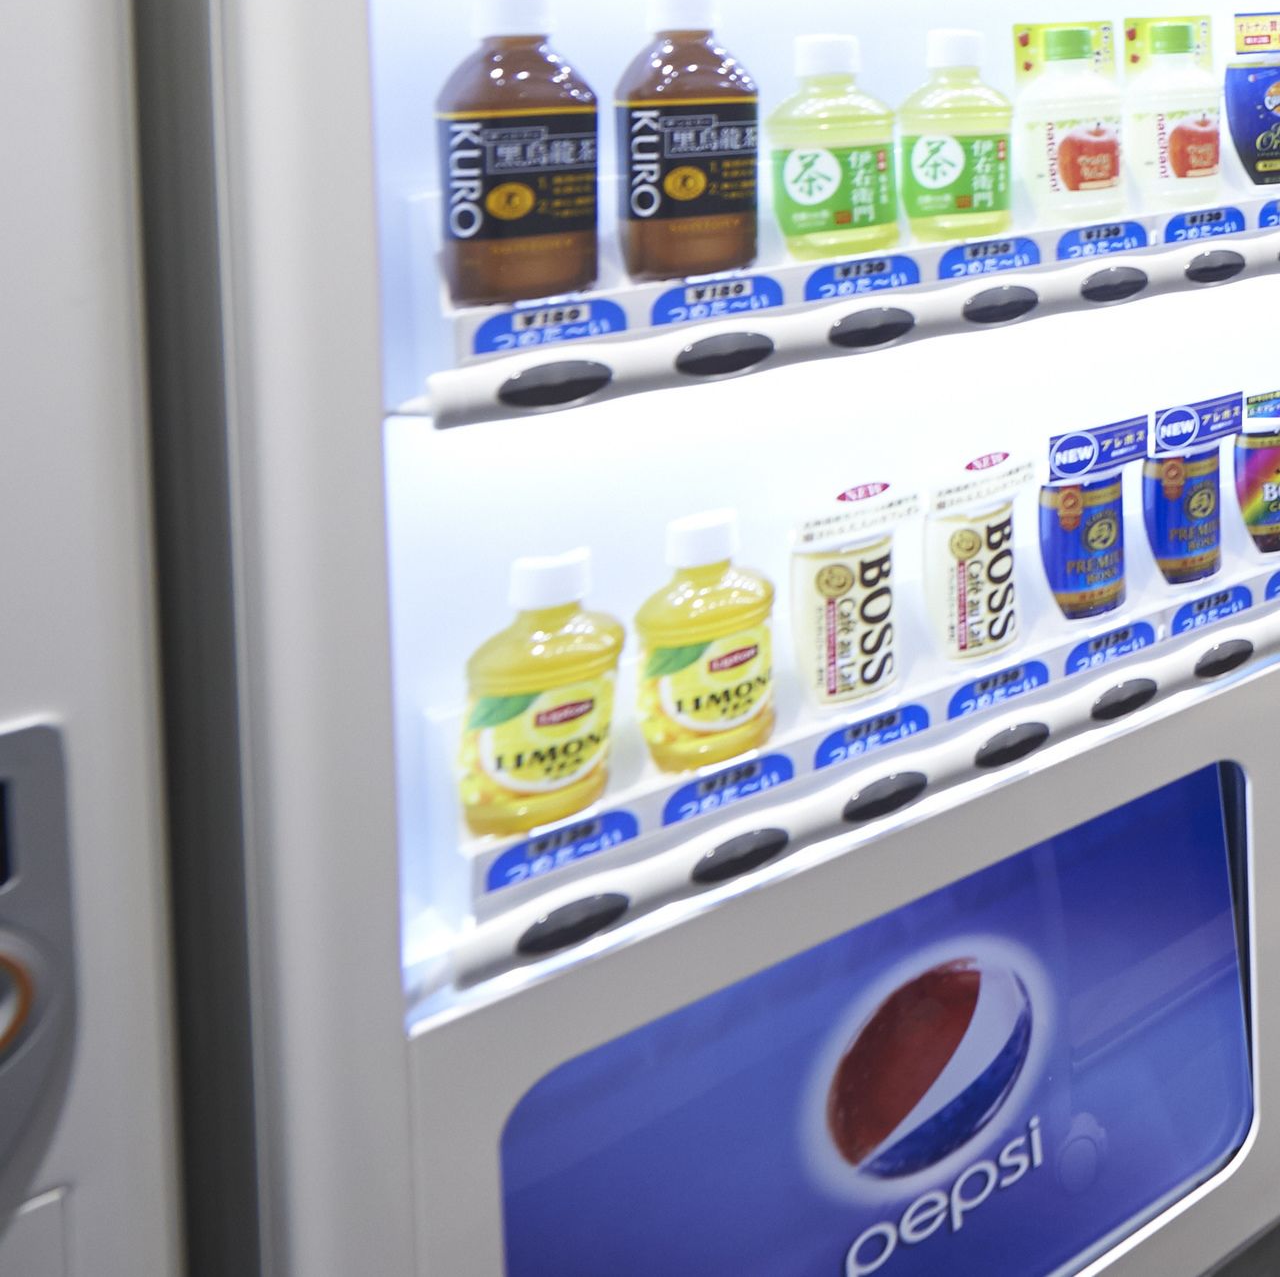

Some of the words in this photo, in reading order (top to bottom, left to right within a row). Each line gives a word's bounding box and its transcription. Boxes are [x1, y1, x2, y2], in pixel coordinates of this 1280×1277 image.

[450, 122, 482, 239] KURO
[631, 109, 661, 217] KURO
[793, 153, 832, 197] 茶
[920, 140, 955, 181] 茶
[971, 139, 994, 209] 伊右衛門
[1055, 444, 1094, 467] NEW
[1160, 417, 1197, 437] NEW
[986, 515, 1015, 642] BOSS
[860, 550, 894, 686] BOSS
[495, 723, 610, 772] LIMON
[846, 1115, 1043, 1277] pepsi
